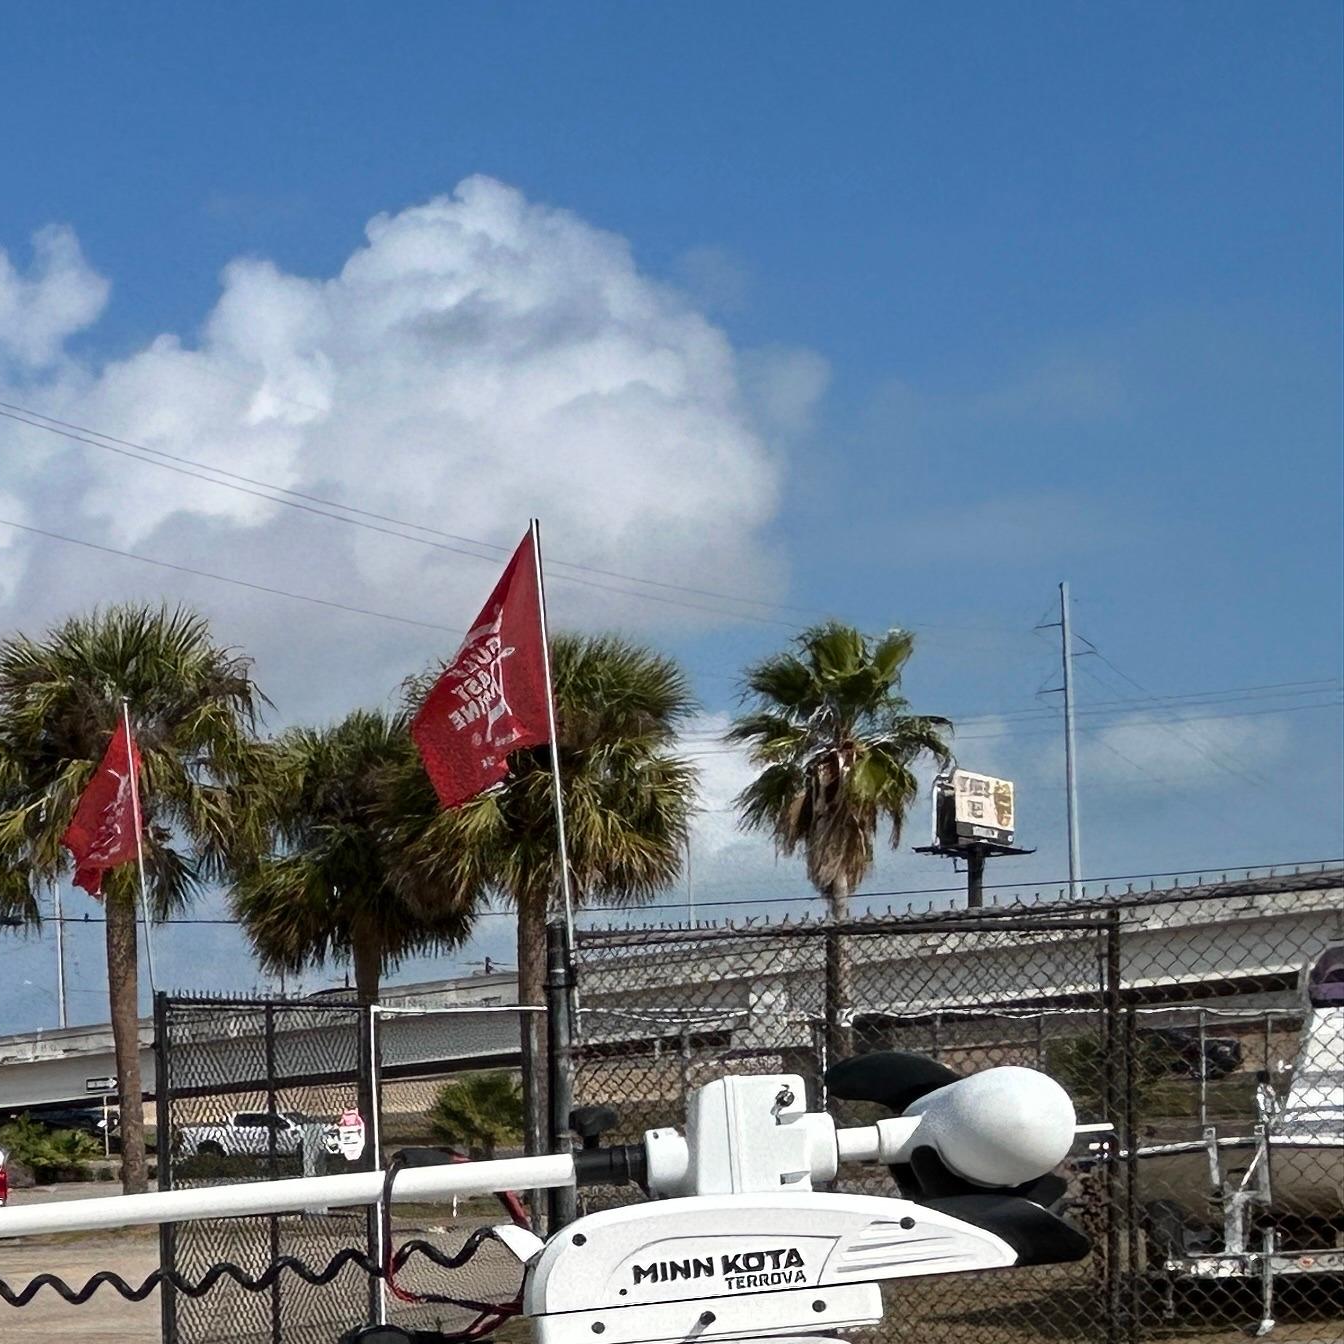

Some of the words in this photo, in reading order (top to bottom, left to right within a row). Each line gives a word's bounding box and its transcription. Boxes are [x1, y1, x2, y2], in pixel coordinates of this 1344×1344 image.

[632, 1256, 714, 1285] MINN
[721, 1248, 805, 1275] KOTA
[725, 1270, 807, 1290] TERROVA
